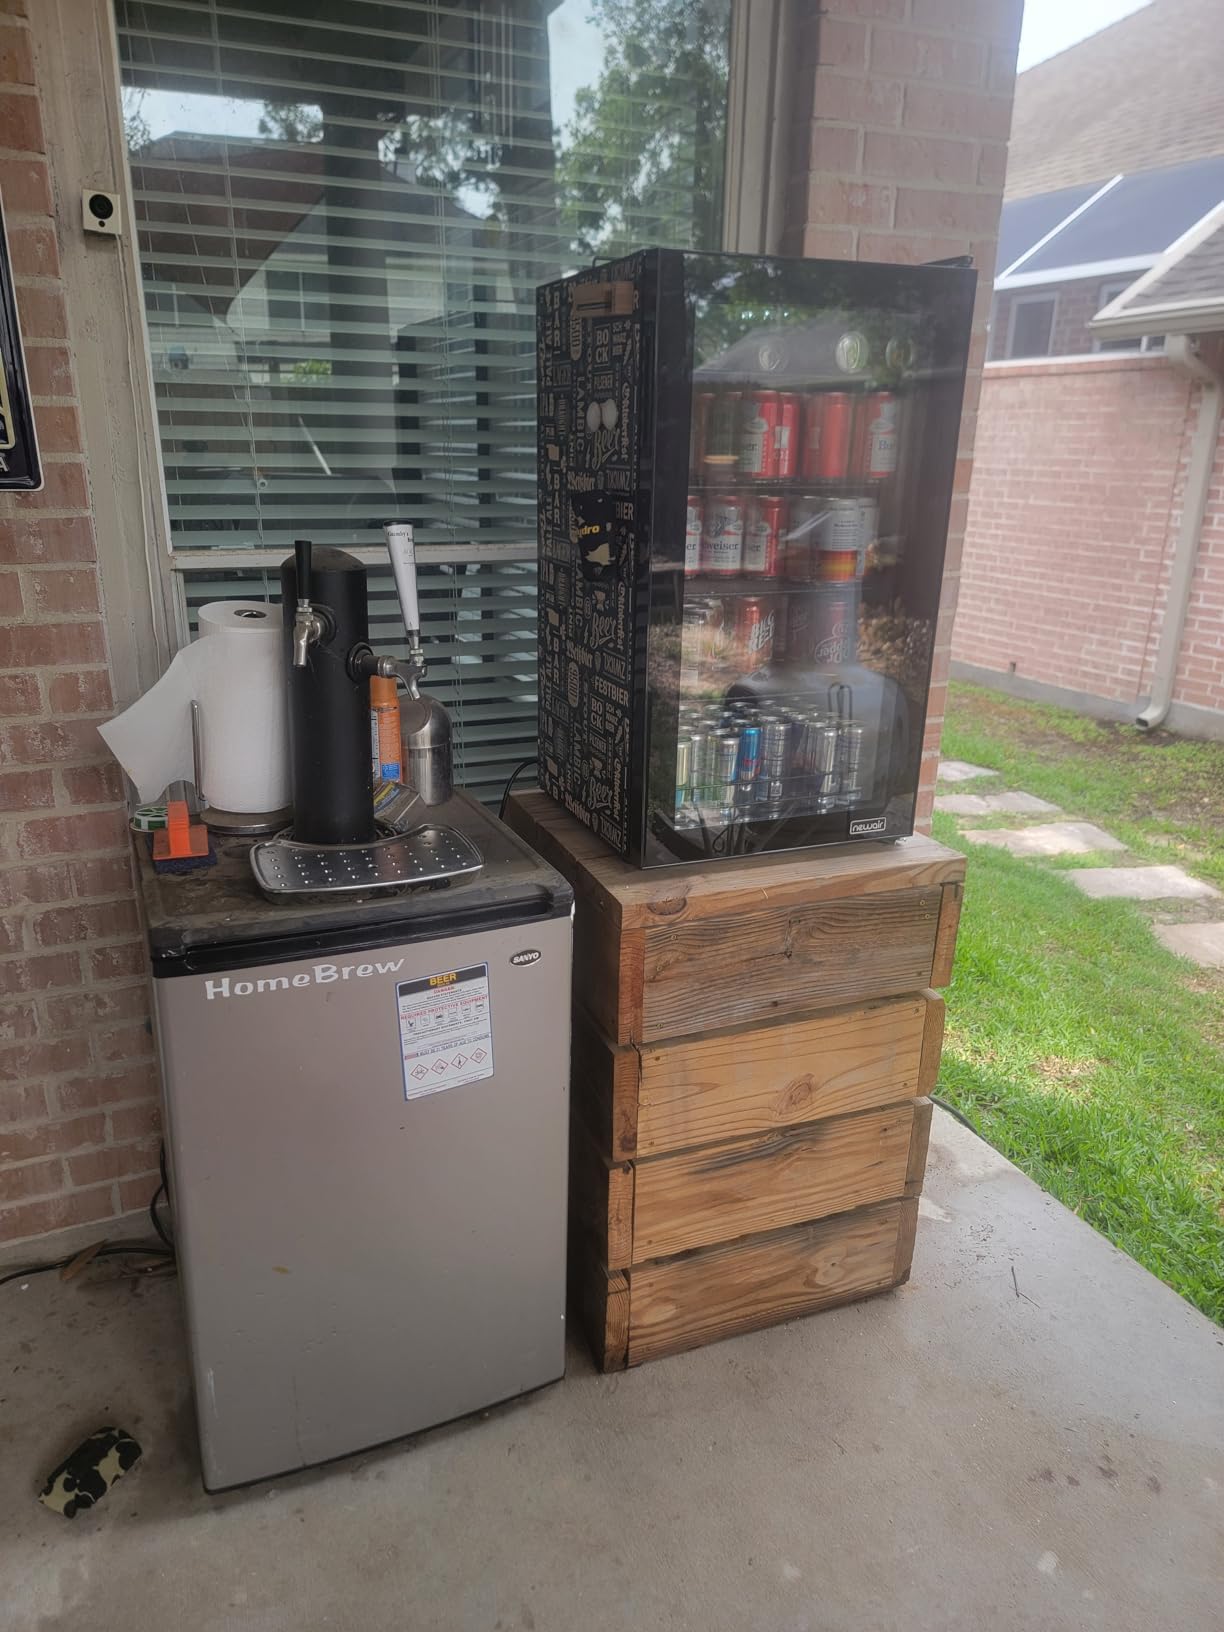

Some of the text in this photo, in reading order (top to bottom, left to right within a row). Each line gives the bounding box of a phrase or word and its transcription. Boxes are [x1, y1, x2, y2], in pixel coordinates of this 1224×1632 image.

[576, 376, 585, 451] LAMBIC
[590, 612, 616, 649] Beer
[593, 675, 629, 707] FESTBIER
[588, 776, 612, 809] Beer
[852, 819, 884, 832] newair
[513, 952, 539, 964] SANYO
[205, 958, 405, 1000] HomeBrew
[430, 972, 456, 986] BEER
